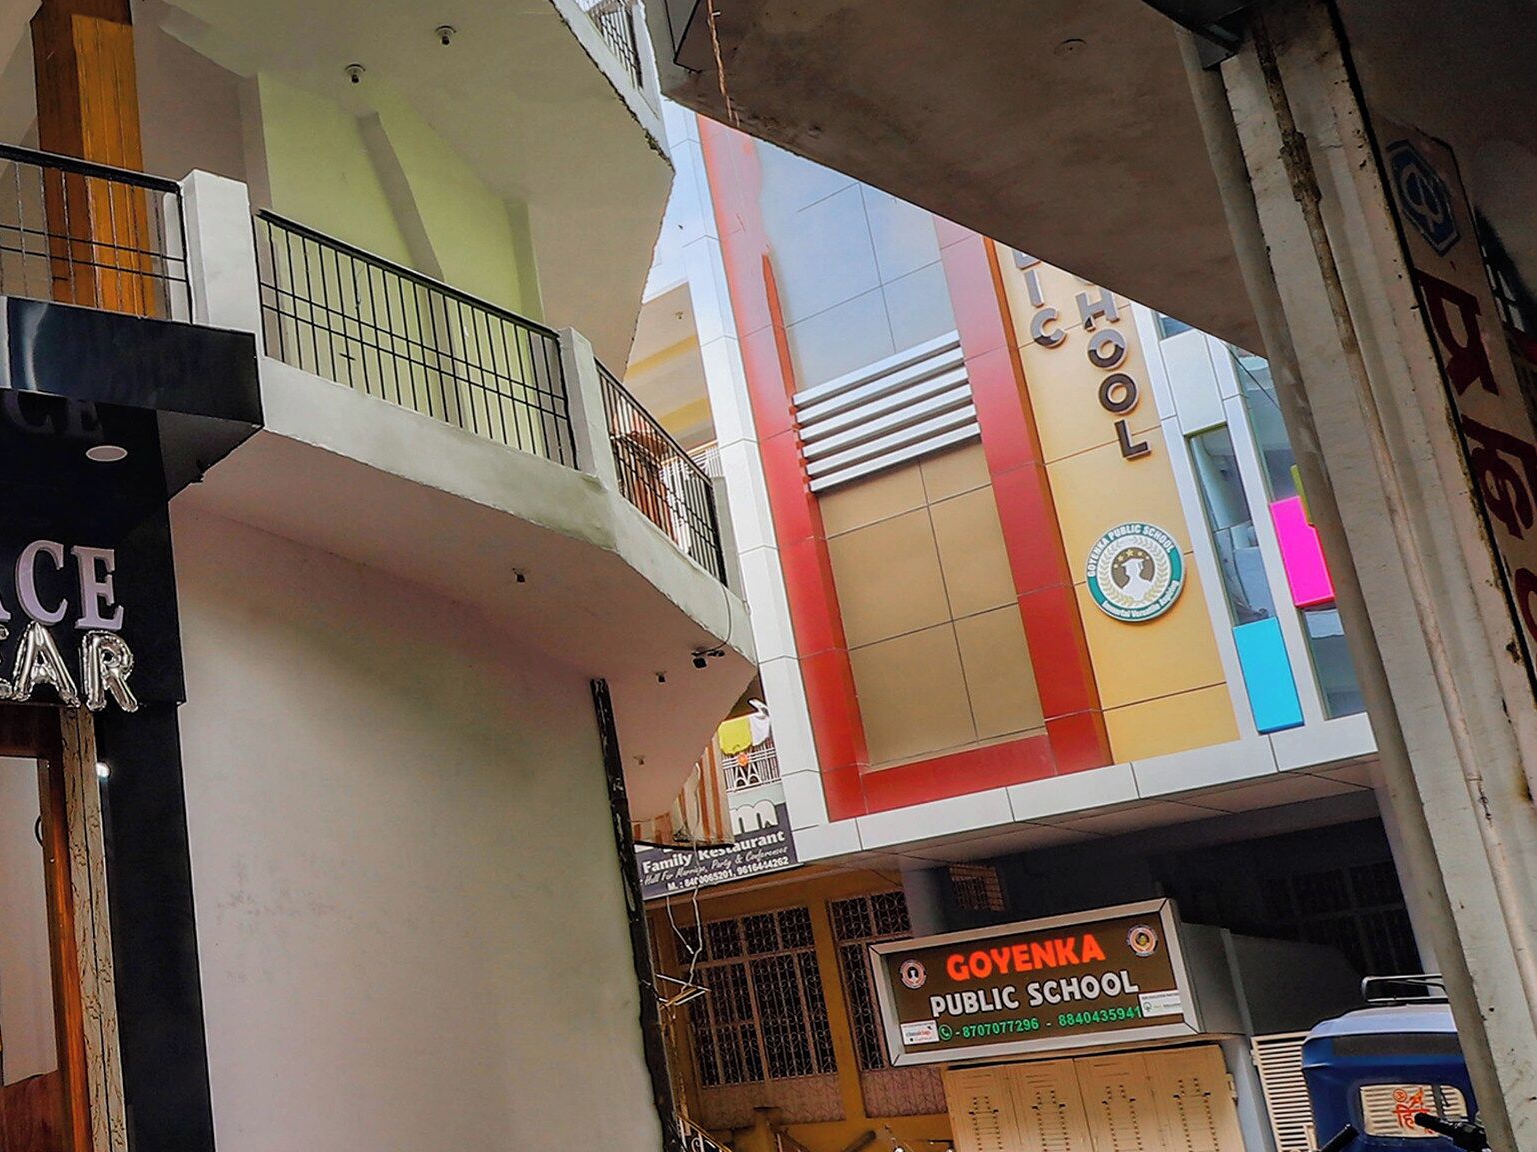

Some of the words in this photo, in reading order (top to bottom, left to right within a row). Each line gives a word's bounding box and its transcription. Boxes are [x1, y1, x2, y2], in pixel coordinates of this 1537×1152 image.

[1087, 535, 1110, 577] GOYENKA
[1108, 524, 1142, 540] PUBLIC
[1143, 526, 1174, 553] SCHOOL
[642, 852, 693, 874] Family
[946, 933, 1106, 982] GOYENKA
[930, 986, 1020, 1018] PUBLIC
[1027, 970, 1139, 1007] SCHOOL
[962, 1018, 1039, 1038] 8707077296
[1058, 1006, 1142, 1027] 8840435941
